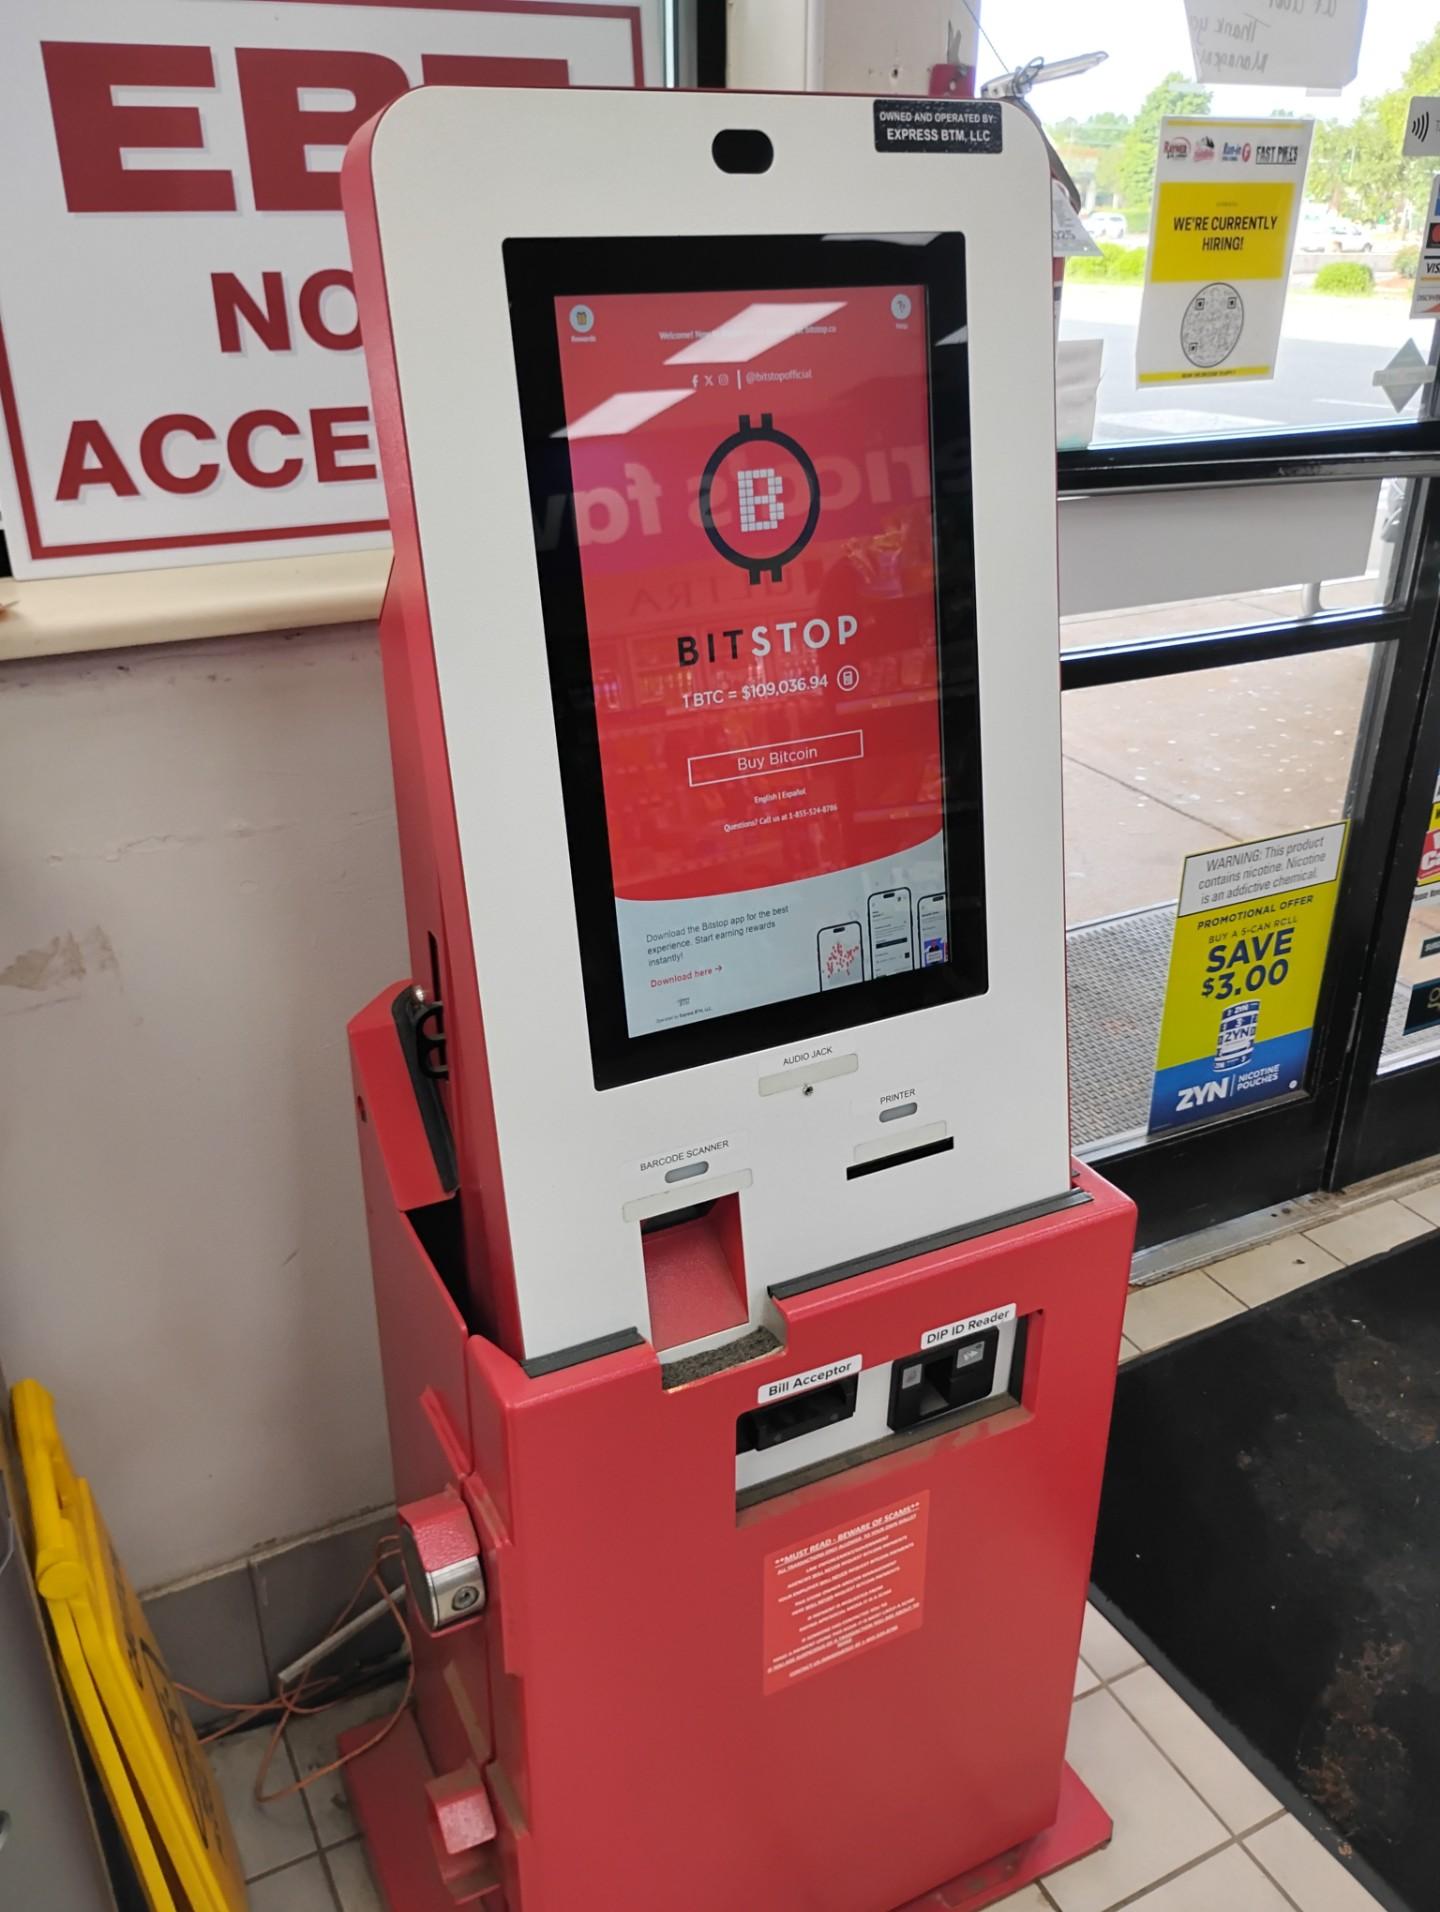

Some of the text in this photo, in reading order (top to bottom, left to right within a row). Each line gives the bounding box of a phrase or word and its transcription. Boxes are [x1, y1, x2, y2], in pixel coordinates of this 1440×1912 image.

[880, 111, 993, 124] OWNED AND OPERATED BY
[887, 128, 991, 142] EXPRESS BTM, LLC
[1256, 146, 1276, 162] FAST
[1174, 215, 1278, 231] WE'RE CURRENTLY
[1202, 237, 1244, 251] HIRING!
[55, 406, 377, 501] ACCE
[677, 615, 857, 666] BITSTOP
[693, 689, 725, 707] BTC
[742, 674, 828, 700] $109,036.94
[737, 746, 818, 770] Buy Bitcoin
[723, 818, 758, 833] Questions?
[759, 815, 771, 825] Call
[1265, 846, 1285, 859] This
[1286, 837, 1324, 857] product
[1198, 852, 1326, 890] contains nicotine. Nicotine
[1201, 895, 1210, 905] is
[1211, 891, 1225, 902] an
[1226, 880, 1271, 899] addictive
[646, 905, 789, 943] Download the Bitstop app for the best
[1197, 895, 1314, 930] PROMOTIONAL OFFER
[647, 920, 776, 955] experience. Start earning rewards
[1208, 932, 1228, 944] BUY
[1231, 930, 1238, 938] A
[1274, 916, 1298, 926] ROLL
[648, 952, 683, 967] instantly!
[1206, 927, 1295, 973] SAVE
[650, 967, 712, 988] Download here
[1201, 958, 1289, 1000] $3.00
[1224, 1028, 1249, 1043] ZYN
[782, 1046, 833, 1066] AUDIO JACK
[1237, 1072, 1279, 1091] POUCHES
[1239, 1063, 1280, 1082] NICOTINE
[880, 1088, 916, 1104] PRINTER
[1175, 1077, 1229, 1112] ZYN
[640, 1140, 730, 1172] BARCODE SCANNER
[926, 1310, 1010, 1345] DIP ID Reader
[768, 1362, 852, 1397] Bill Acceptor
[809, 1537, 831, 1553] READ
